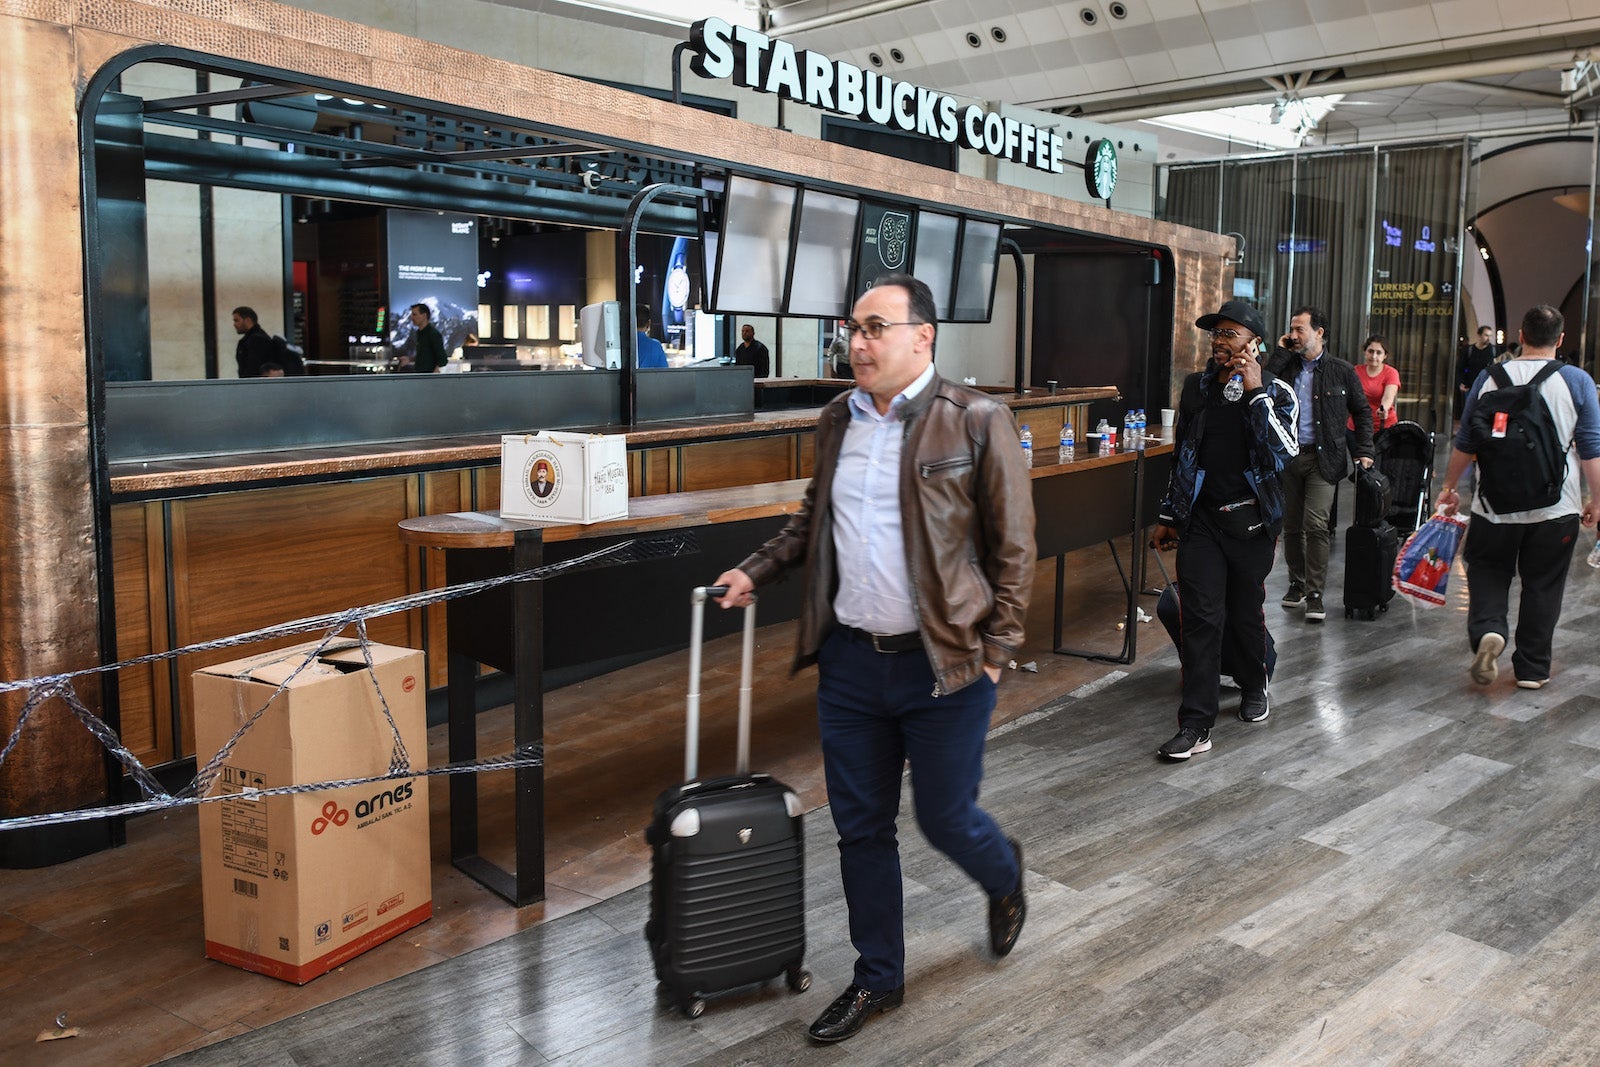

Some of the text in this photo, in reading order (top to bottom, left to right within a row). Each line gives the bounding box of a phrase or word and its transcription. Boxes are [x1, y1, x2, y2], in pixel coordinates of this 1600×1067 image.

[701, 16, 1064, 174] STARBUCKS COFFEE
[1373, 283, 1415, 292] TURKISH
[1372, 291, 1415, 300] AIRLINES
[1372, 303, 1454, 318] lounge istanbul
[355, 781, 413, 818] arnes
